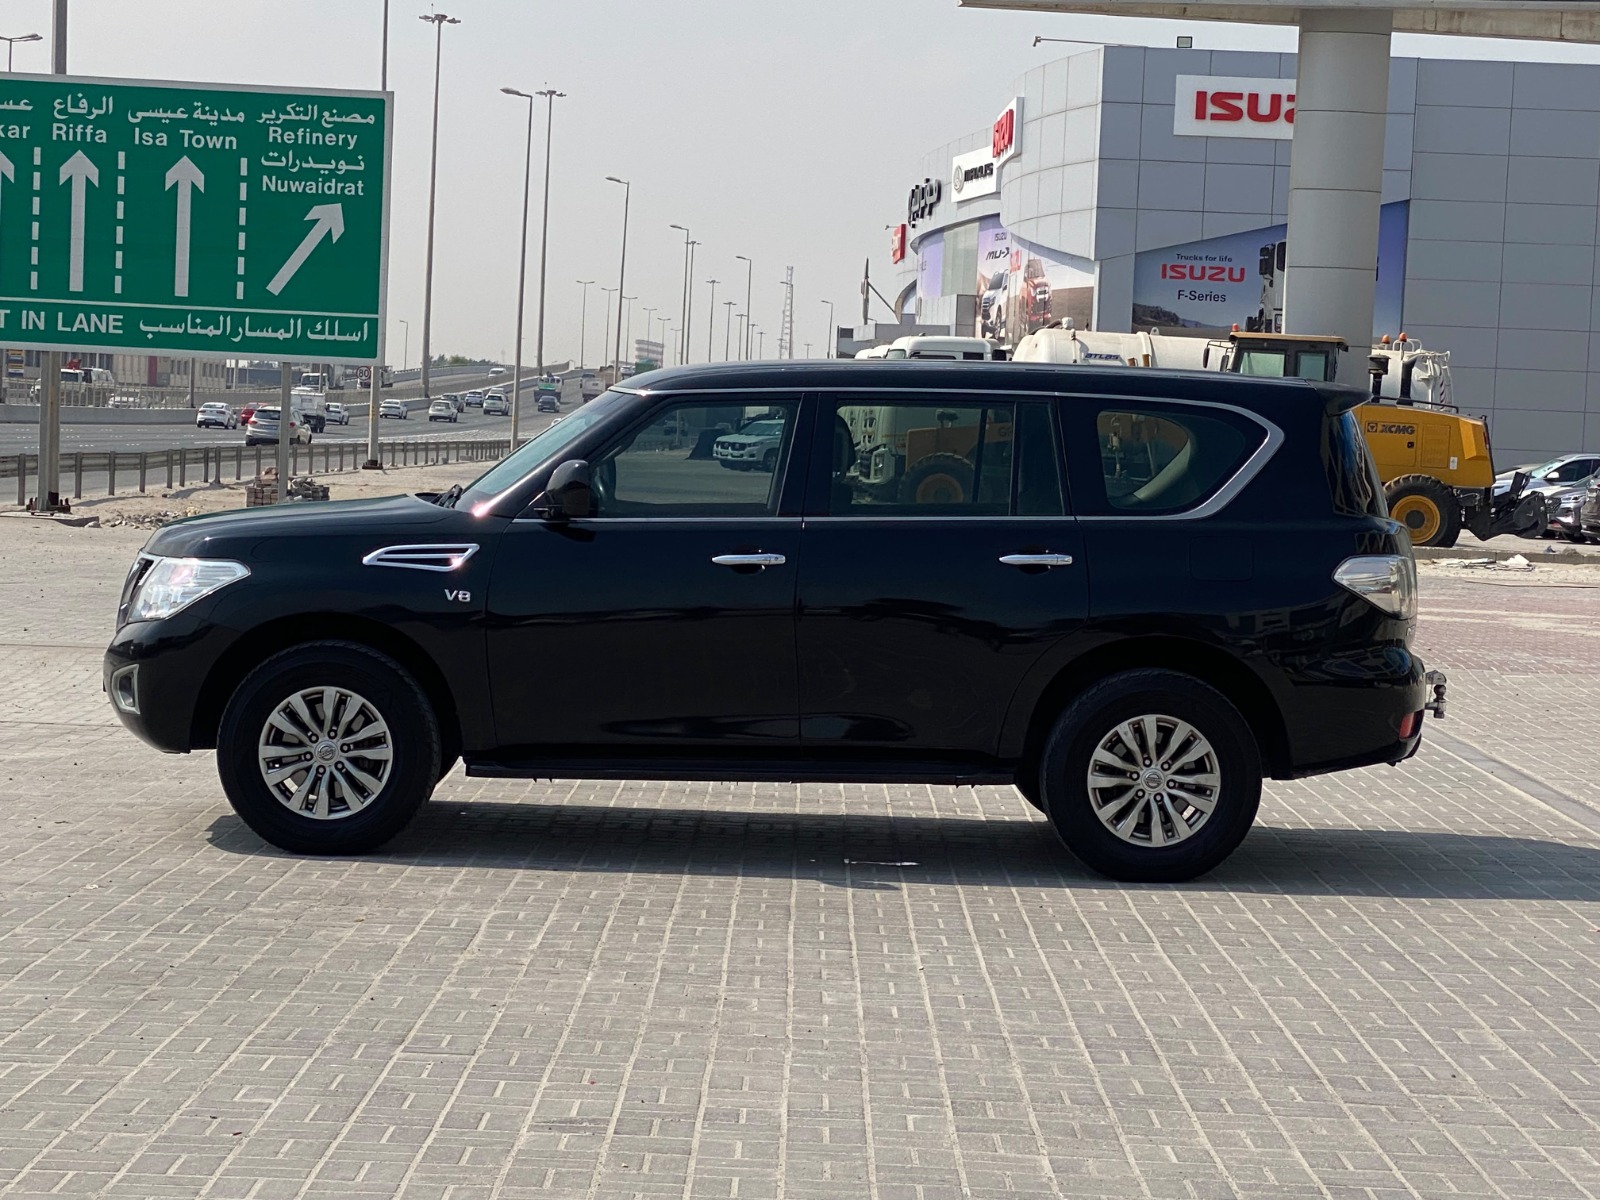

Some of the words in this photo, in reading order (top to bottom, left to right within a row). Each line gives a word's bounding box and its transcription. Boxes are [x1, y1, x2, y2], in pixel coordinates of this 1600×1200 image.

[53, 93, 113, 120] الرفاع
[127, 107, 189, 124] عيسى
[192, 101, 245, 126] مدينة
[256, 103, 318, 125] التكرير
[321, 108, 375, 128] مصنع
[53, 122, 107, 143] Riffa
[134, 127, 168, 146] Isa
[180, 129, 237, 150] Town
[268, 126, 358, 150] Refinery
[261, 151, 365, 175] نويدرات
[262, 175, 364, 196] Nuwaidrat
[1176, 253, 1203, 262] Trucks
[1205, 254, 1217, 262] for
[1218, 255, 1233, 263] life
[1160, 263, 1246, 283] ISUZU
[1177, 289, 1227, 303] F-Series
[21, 310, 45, 330] IN
[57, 312, 124, 334] LANE
[139, 313, 231, 340] المناسب
[231, 316, 302, 342] المسار
[307, 319, 368, 342] اسلك
[1379, 424, 1416, 435] XCMG
[444, 588, 471, 603] V8
